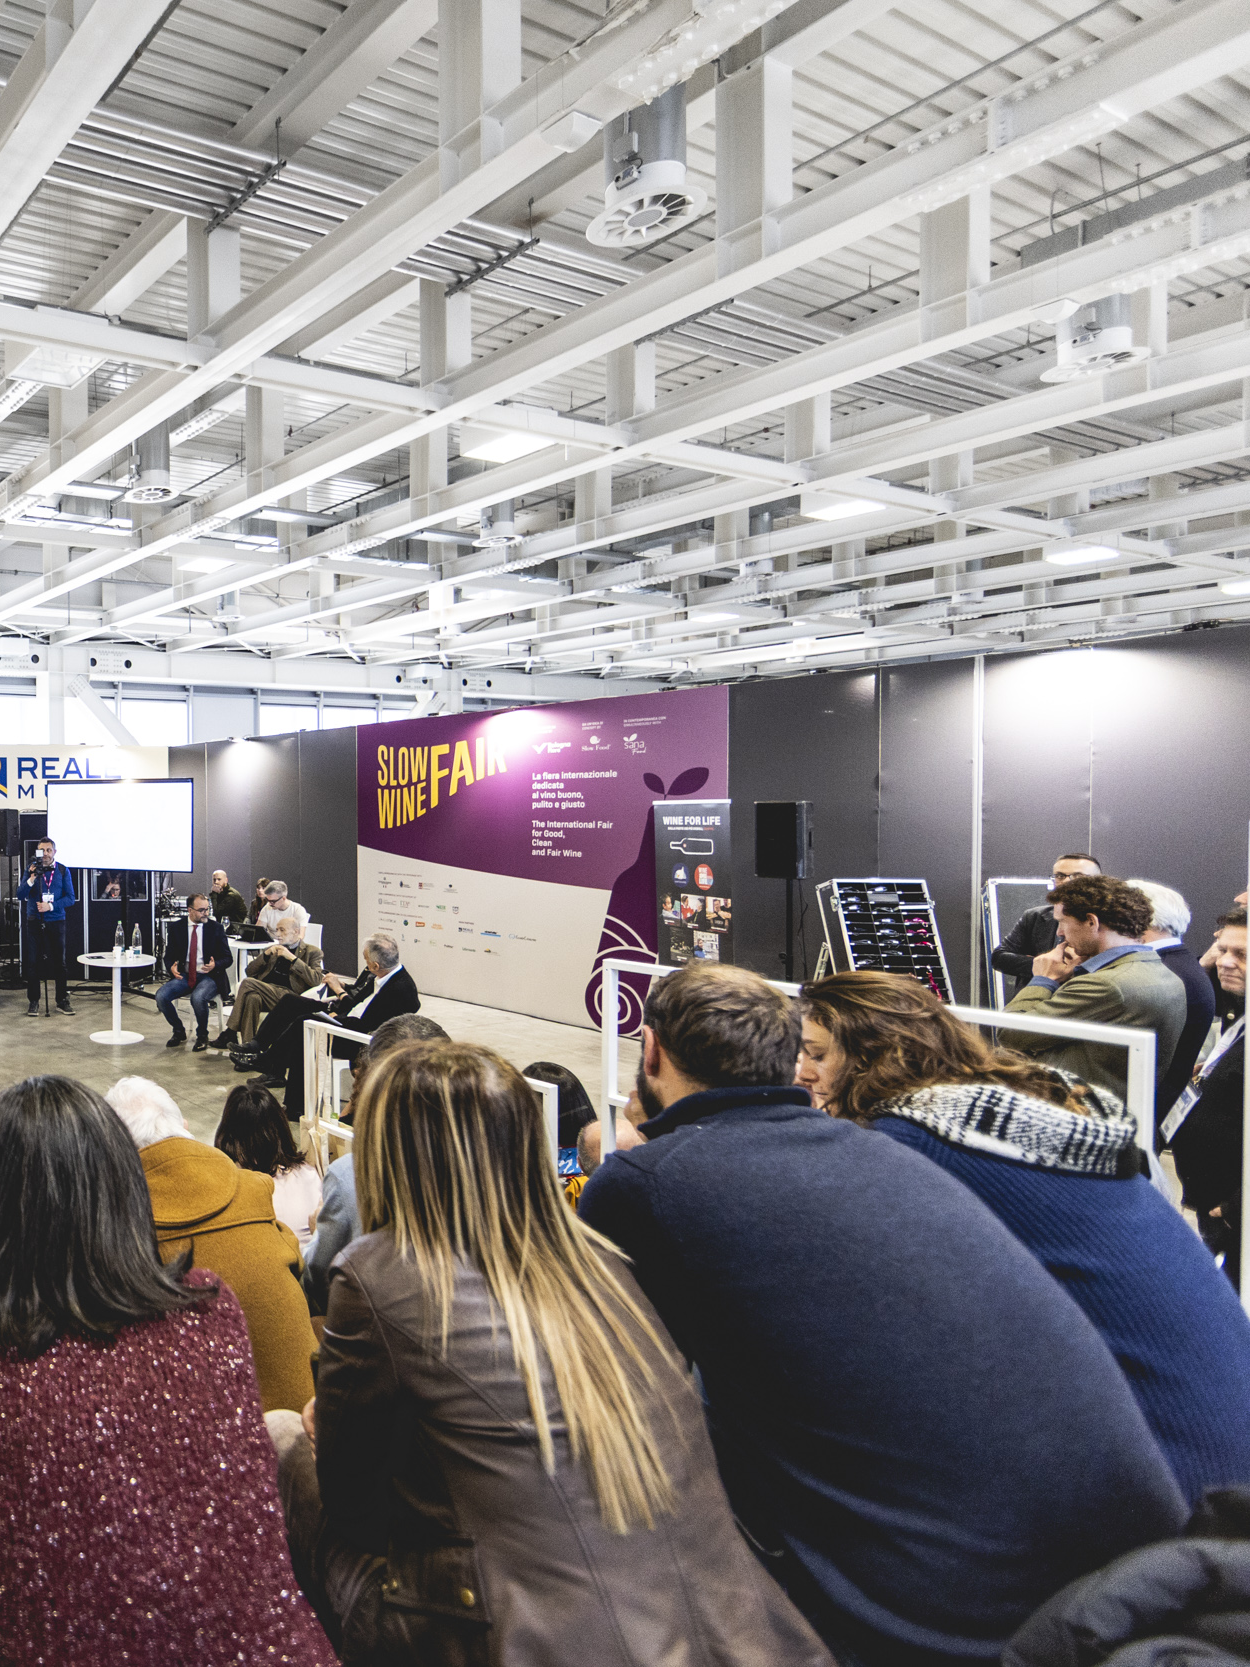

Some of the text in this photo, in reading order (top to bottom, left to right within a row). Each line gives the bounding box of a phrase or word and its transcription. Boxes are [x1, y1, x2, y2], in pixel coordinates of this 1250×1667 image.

[377, 744, 429, 787] SLOW
[532, 770, 618, 781] La fiera internazionale
[532, 781, 565, 790] dedicata
[532, 791, 584, 800] al vino buono,
[377, 781, 427, 829] WINE
[532, 800, 553, 810] pulito
[561, 801, 586, 810] giusto
[532, 820, 613, 829] The International Fair
[662, 816, 721, 826] WINE FOR LIFE
[532, 829, 566, 839] for Good,
[532, 839, 553, 847] Clean
[546, 849, 561, 857] Fair
[562, 849, 582, 857] Wine
